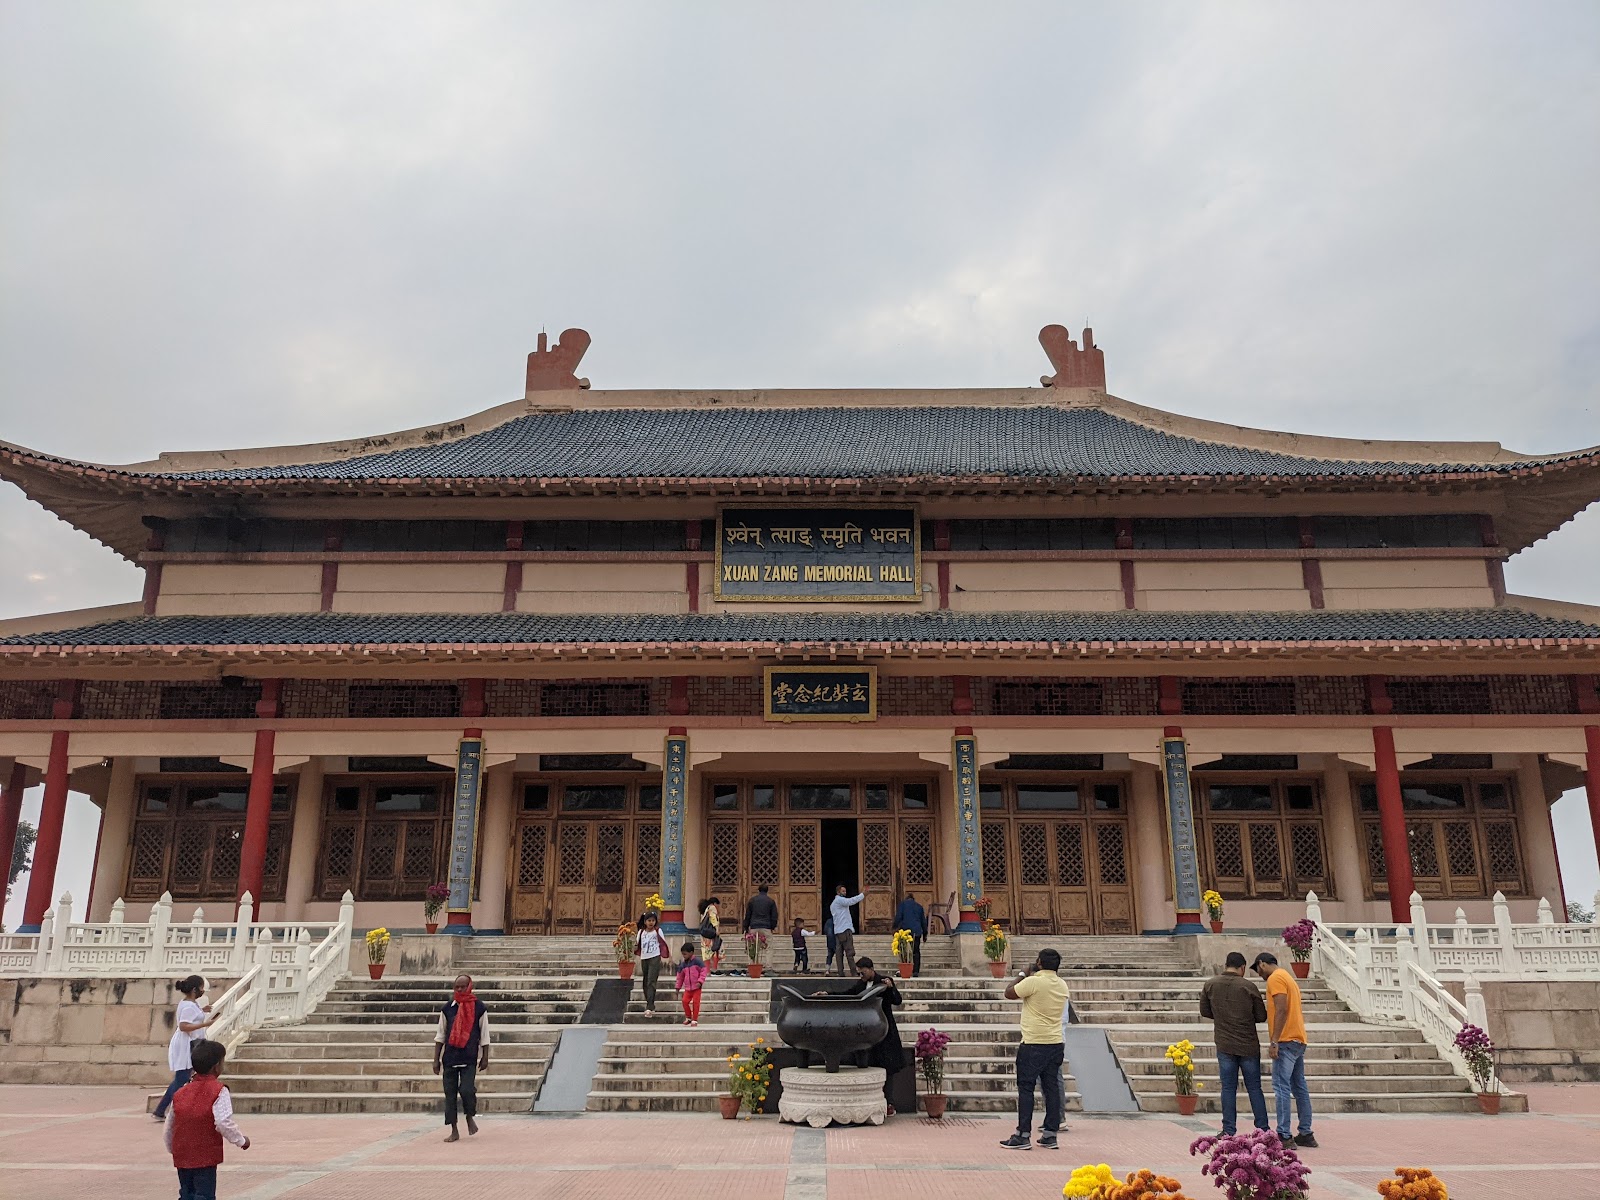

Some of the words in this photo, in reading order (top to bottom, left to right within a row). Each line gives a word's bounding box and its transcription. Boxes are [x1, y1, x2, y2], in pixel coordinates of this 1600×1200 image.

[819, 522, 863, 548] स्मृति
[870, 527, 911, 544] भवन
[724, 565, 758, 582] XUAN
[764, 565, 798, 582] ZANG
[804, 565, 873, 582] MEMORIAL
[880, 565, 912, 582] HALL
